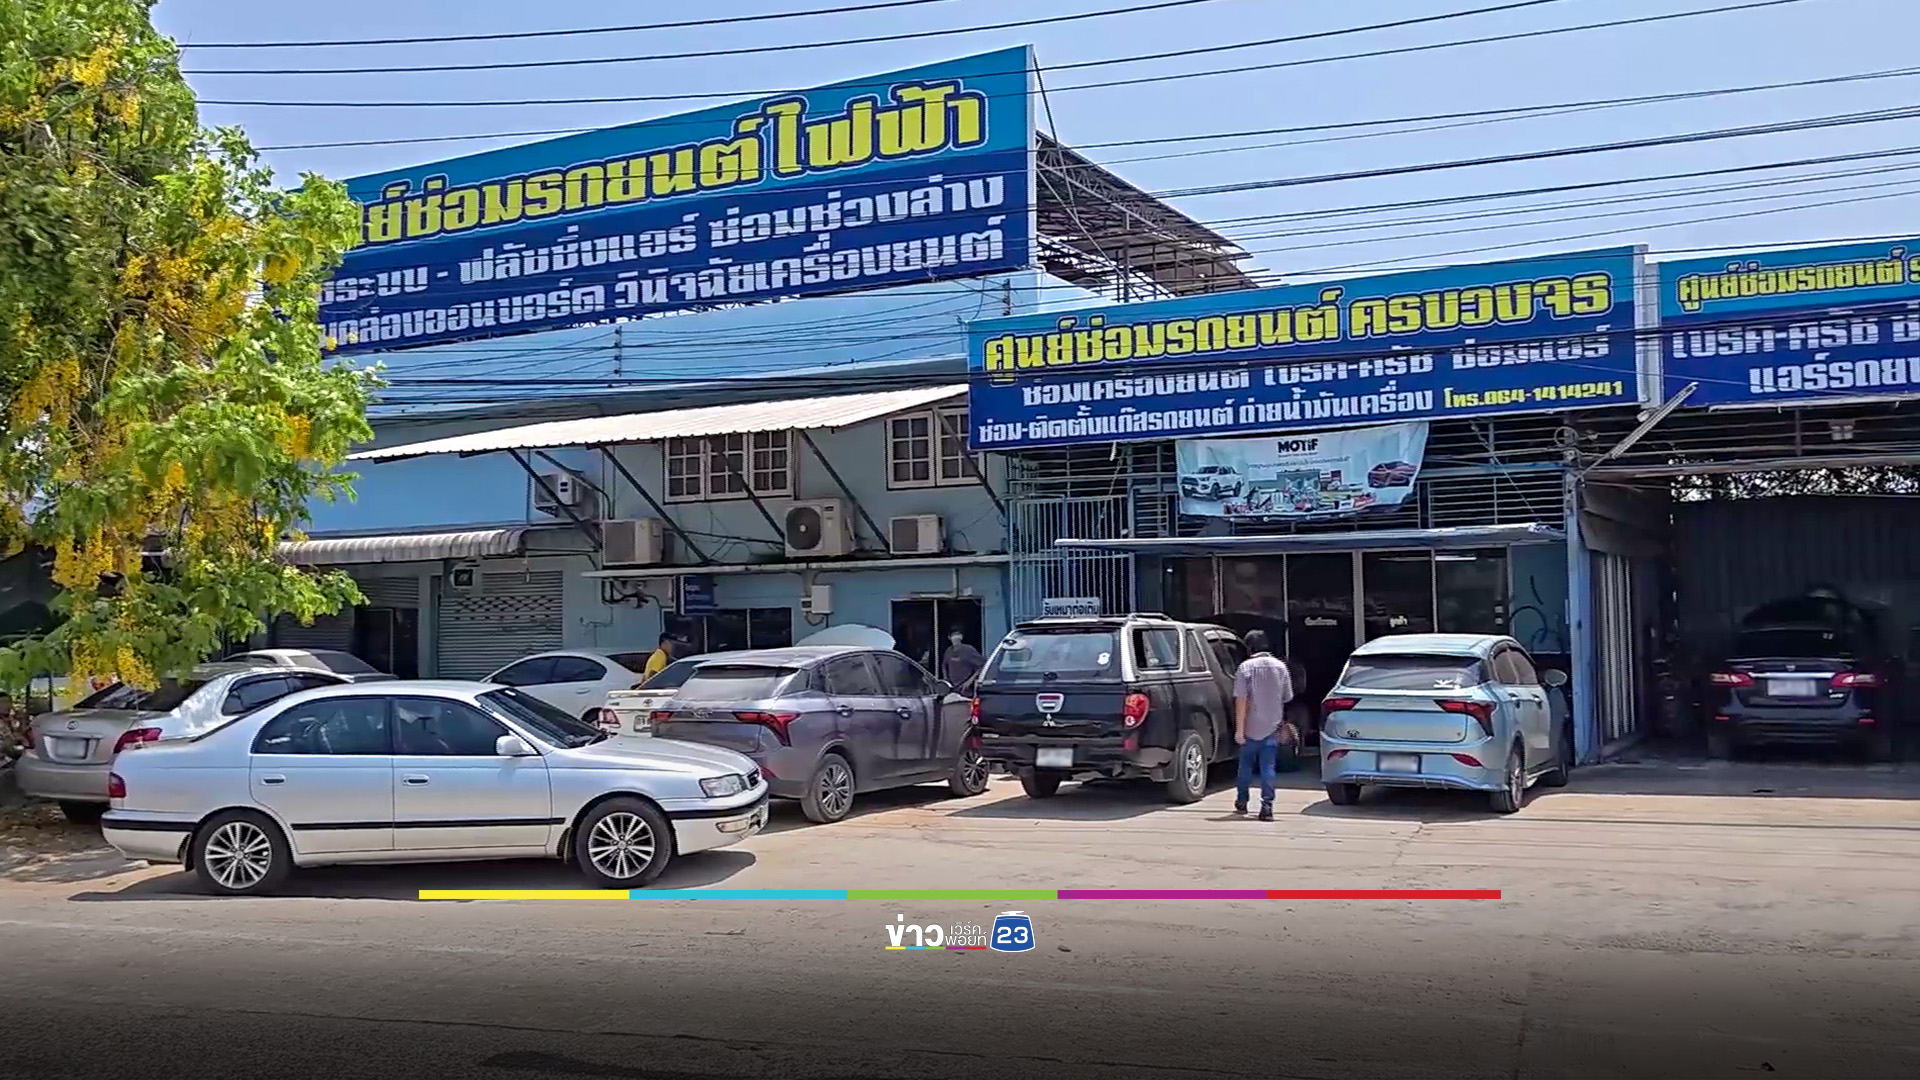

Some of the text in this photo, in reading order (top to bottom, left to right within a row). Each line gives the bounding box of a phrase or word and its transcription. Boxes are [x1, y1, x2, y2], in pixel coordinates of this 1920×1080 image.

[708, 174, 1004, 248] ซ่อมช่วงล่าง
[1678, 248, 1905, 311] ศูนย์ซ่อมรถยนต์
[985, 274, 1610, 382] ศูนย์ซ่อมรถยนต์ ครบวงจร
[1239, 380, 1433, 424] ถ่ายน้ำมันเครื่อง
